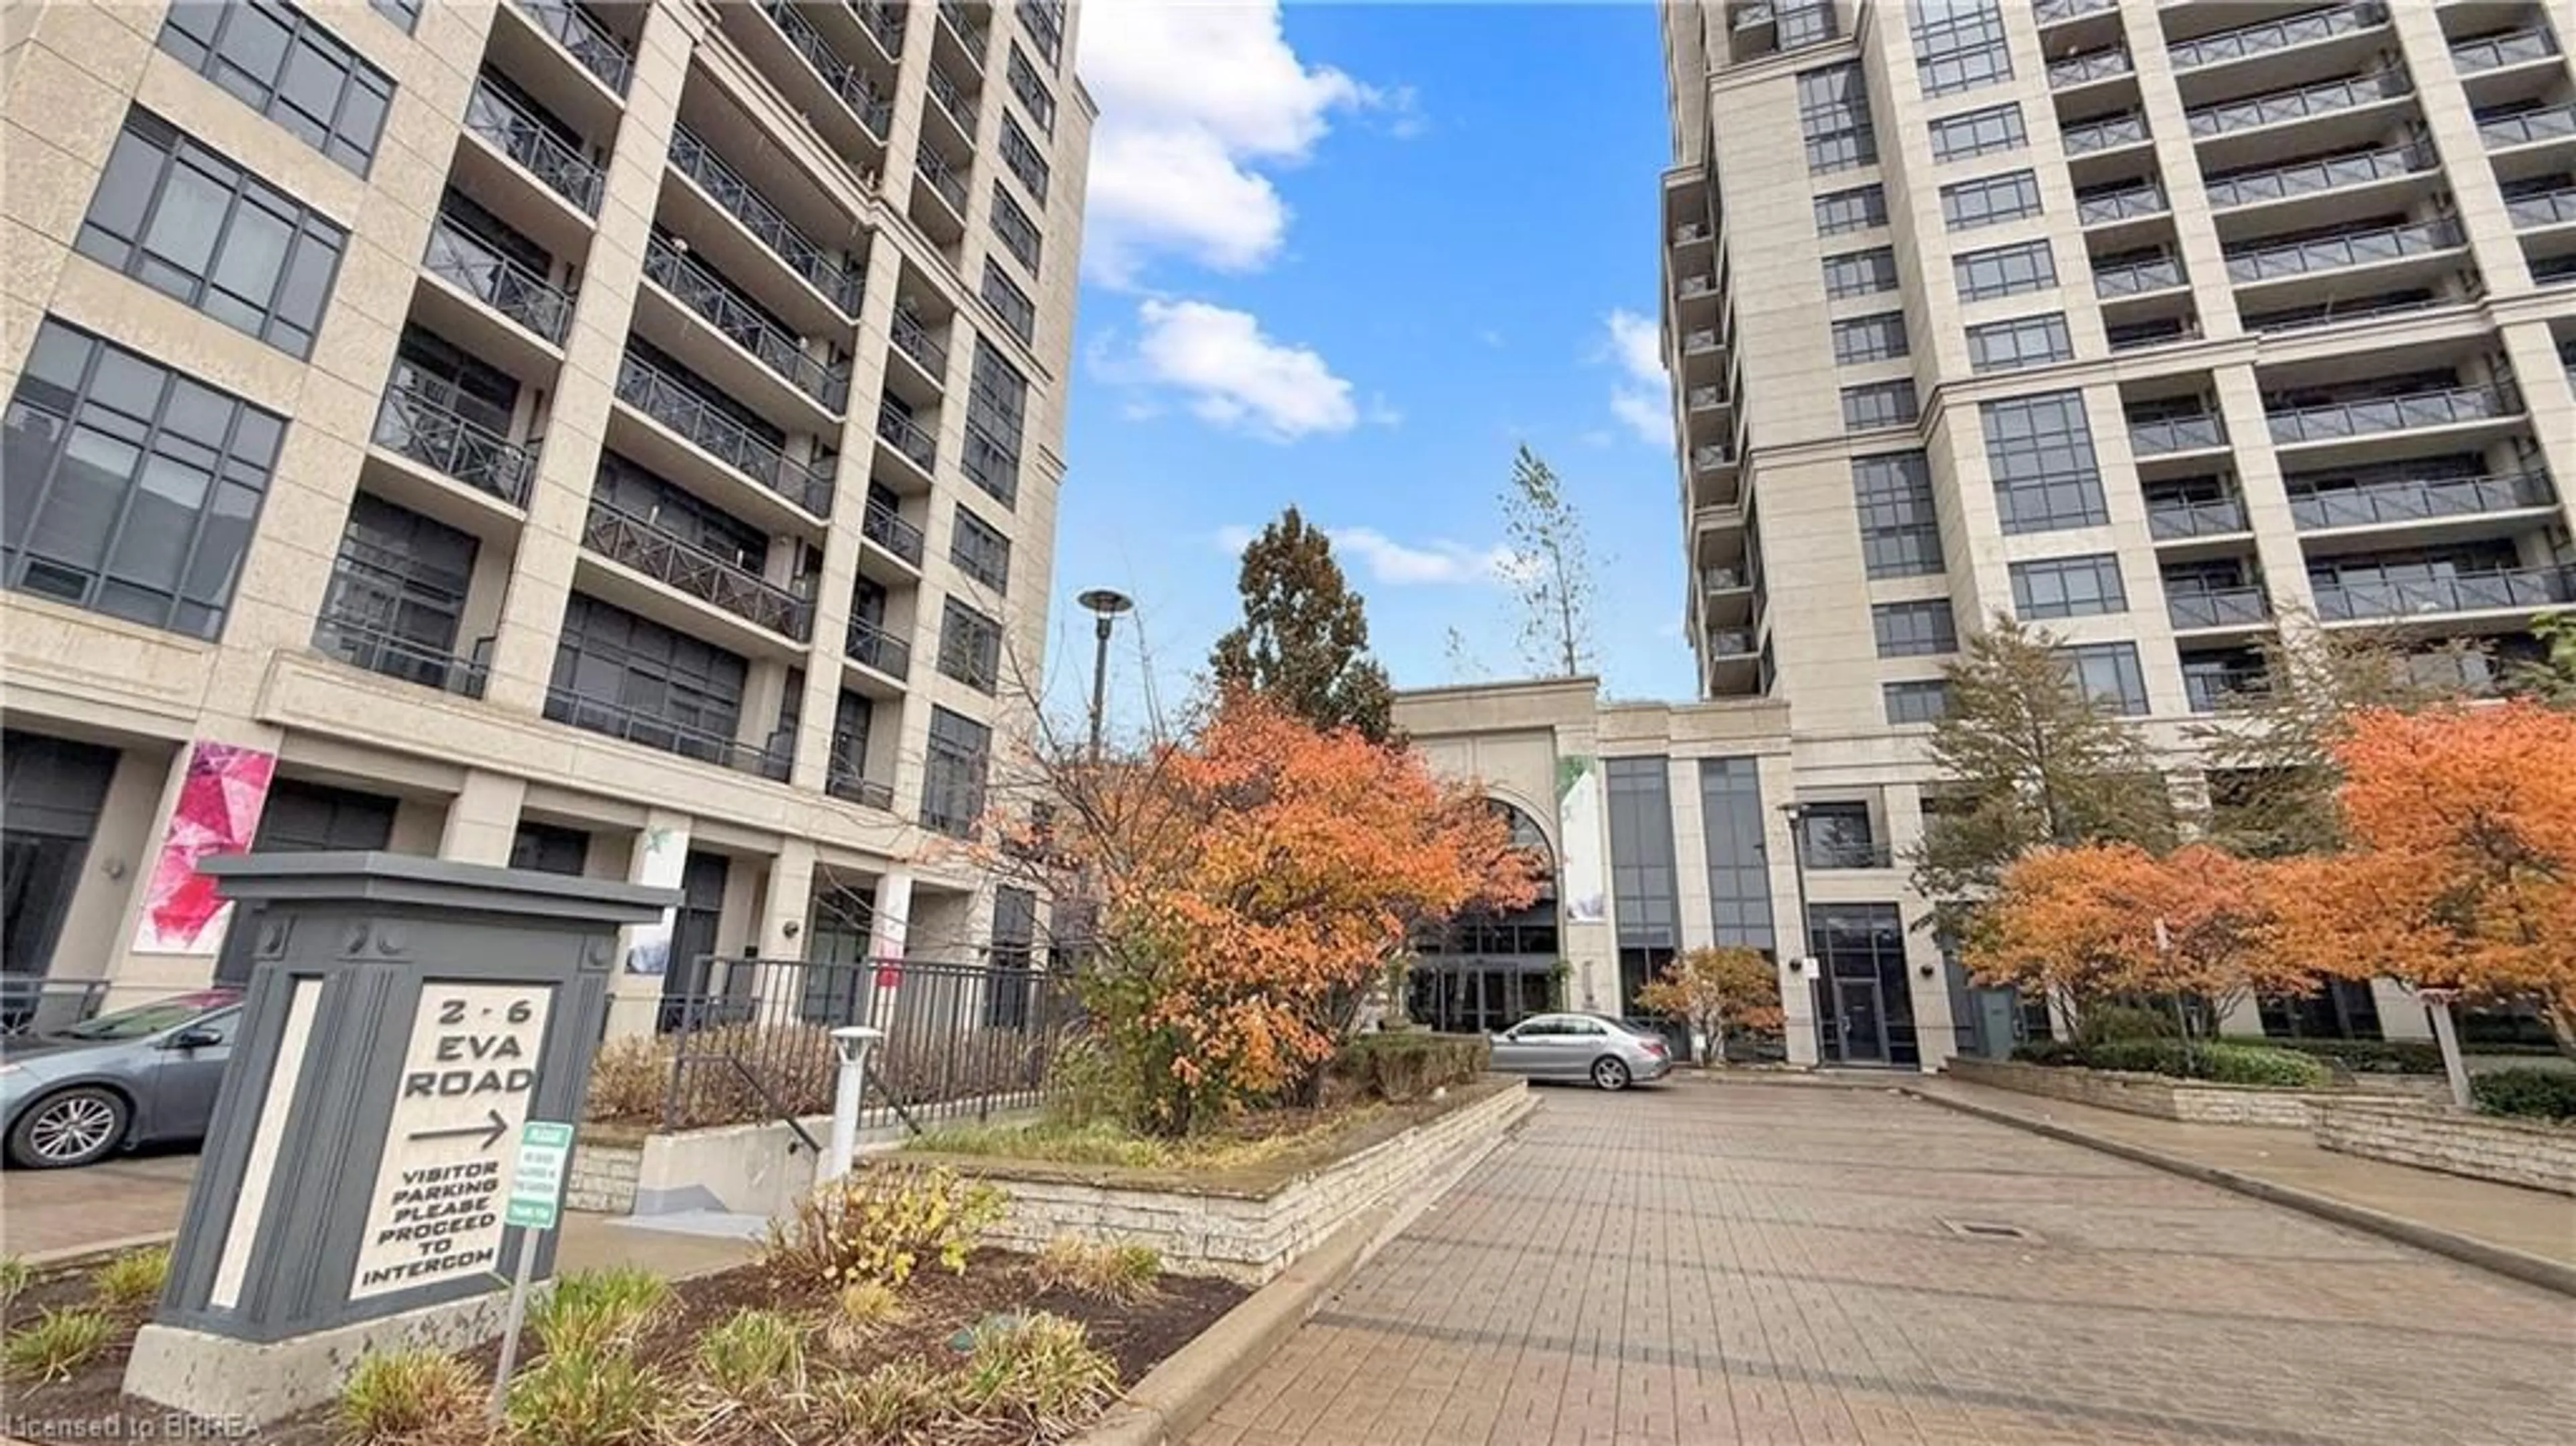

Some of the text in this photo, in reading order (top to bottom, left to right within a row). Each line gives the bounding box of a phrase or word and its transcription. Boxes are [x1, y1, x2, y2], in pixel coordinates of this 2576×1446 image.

[438, 999, 467, 1025] 2
[508, 999, 532, 1024] 6
[437, 1035, 522, 1062] EVA
[404, 1068, 535, 1098] ROAD
[402, 1161, 499, 1184] VISITOR
[392, 1178, 498, 1205] PARKING
[394, 1197, 490, 1223] PLEASE
[378, 1213, 496, 1245] PROCEED
[419, 1238, 452, 1256] TO
[361, 1247, 494, 1286] INTERCOM
